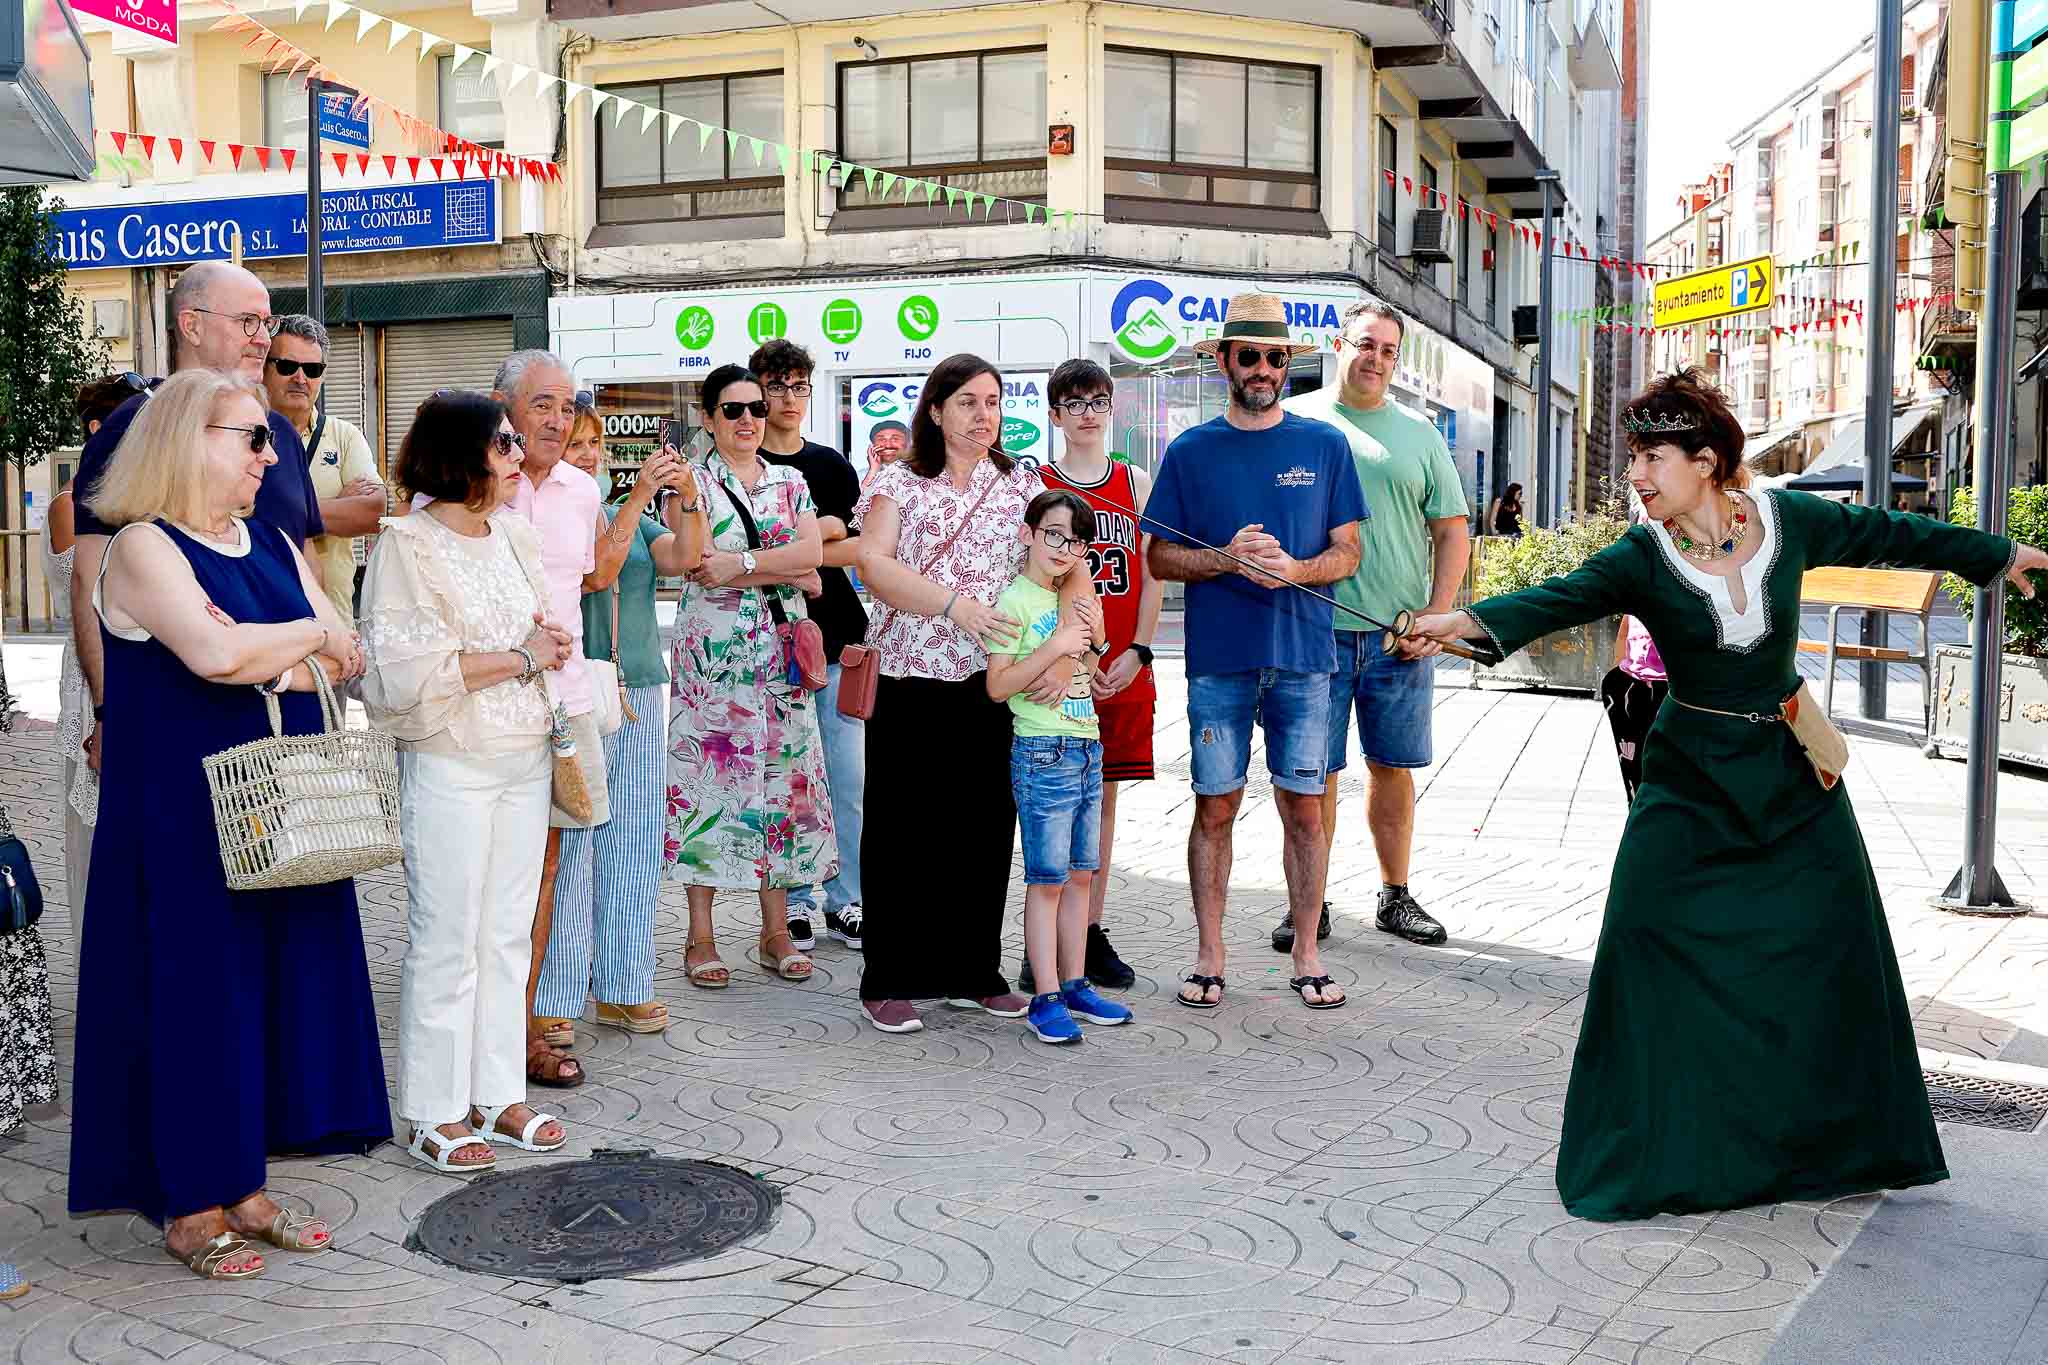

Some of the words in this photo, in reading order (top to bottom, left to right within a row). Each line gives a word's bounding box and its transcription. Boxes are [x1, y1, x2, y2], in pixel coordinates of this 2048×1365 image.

[115, 5, 173, 37] MODA
[322, 191, 369, 214] ESORÍA
[371, 192, 416, 210] FISCAL
[292, 215, 351, 235] LARAL
[361, 209, 431, 229] CONTABLE
[52, 218, 106, 263] uis
[251, 230, 279, 251] S.L.
[321, 234, 403, 250] www.lcasero.com
[1657, 284, 1724, 315] ayuntamiento
[679, 356, 711, 368] FIBRA
[834, 351, 849, 362] TV
[904, 347, 932, 359] FIJO
[1085, 546, 1130, 597] 23
